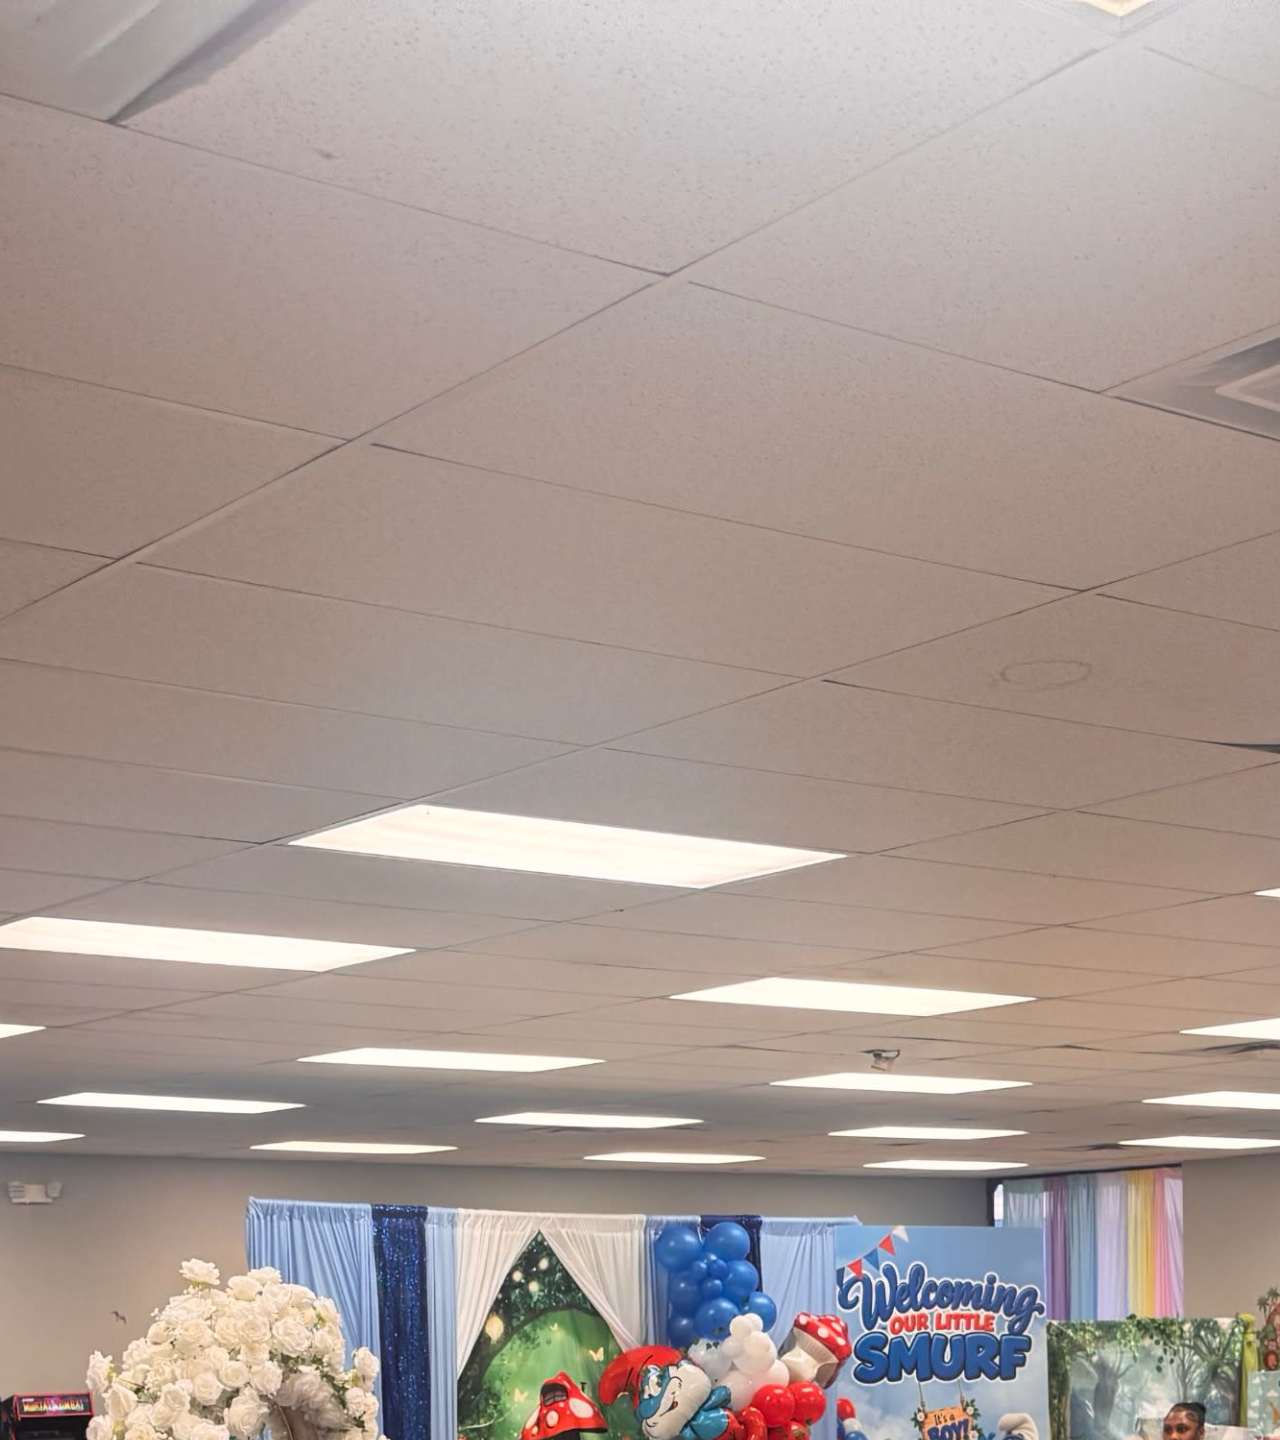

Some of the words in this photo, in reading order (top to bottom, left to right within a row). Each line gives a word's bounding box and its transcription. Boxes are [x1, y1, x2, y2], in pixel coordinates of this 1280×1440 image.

[838, 1263, 1045, 1335] Welcoming
[889, 1313, 930, 1336] OUR
[934, 1312, 996, 1333] LITTLE
[853, 1331, 1033, 1384] SMURF
